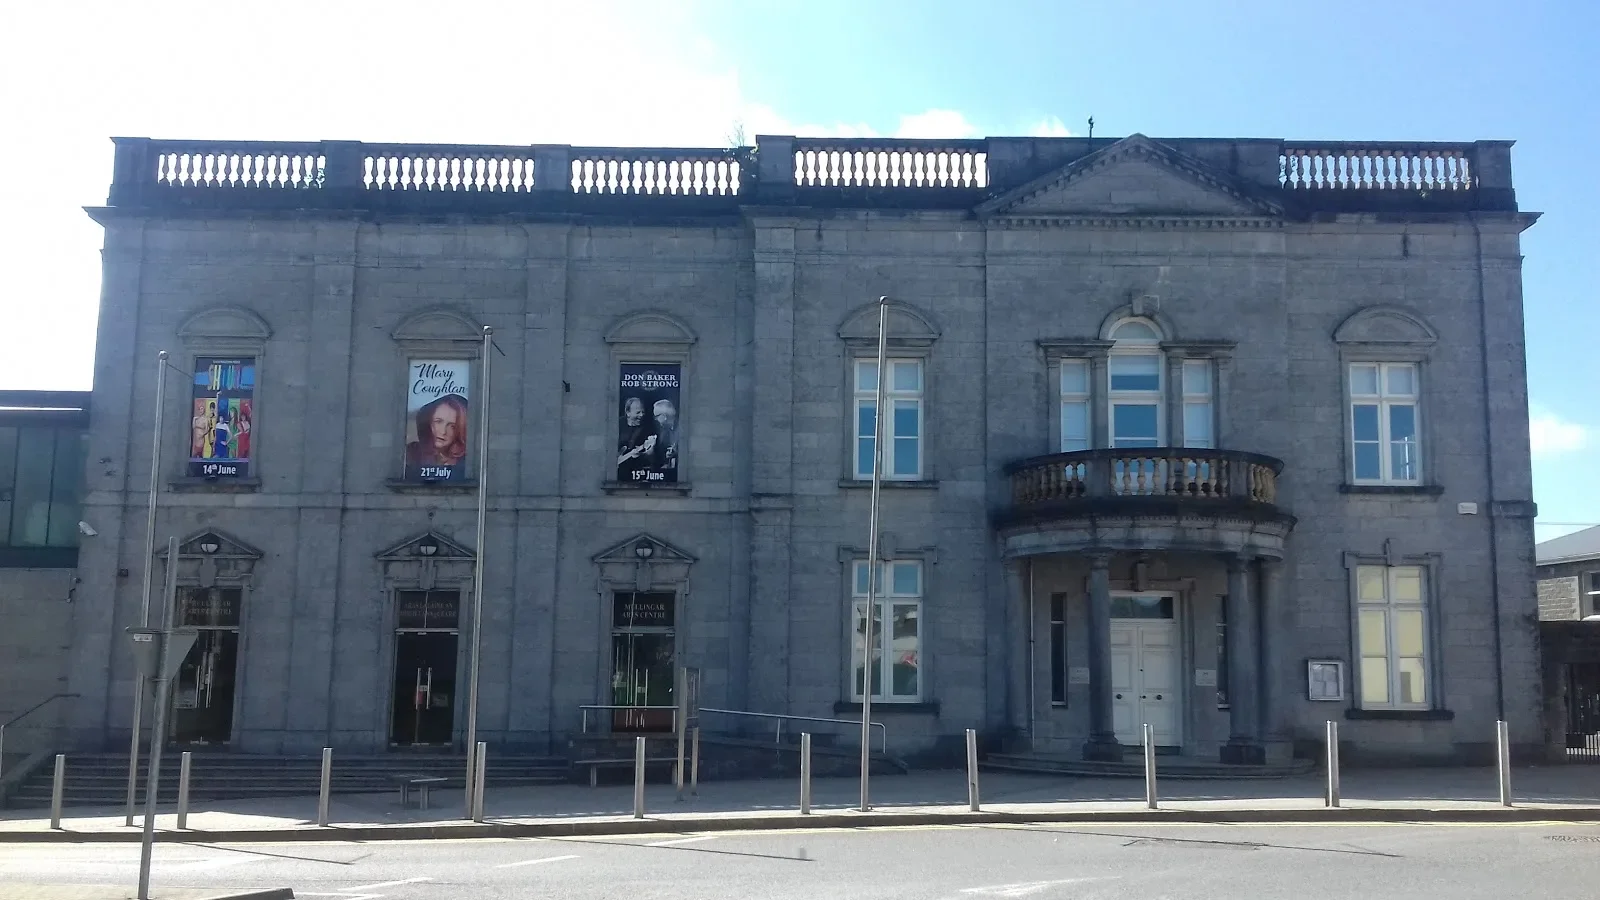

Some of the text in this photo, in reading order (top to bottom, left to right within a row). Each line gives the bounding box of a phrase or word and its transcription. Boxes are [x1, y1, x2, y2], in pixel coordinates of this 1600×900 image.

[413, 363, 454, 382] Mary
[413, 379, 466, 397] Coughlan
[641, 380, 679, 388] STRONG
[203, 464, 237, 475] 14th June
[420, 467, 452, 479] 21st July
[631, 469, 665, 480] 15th June
